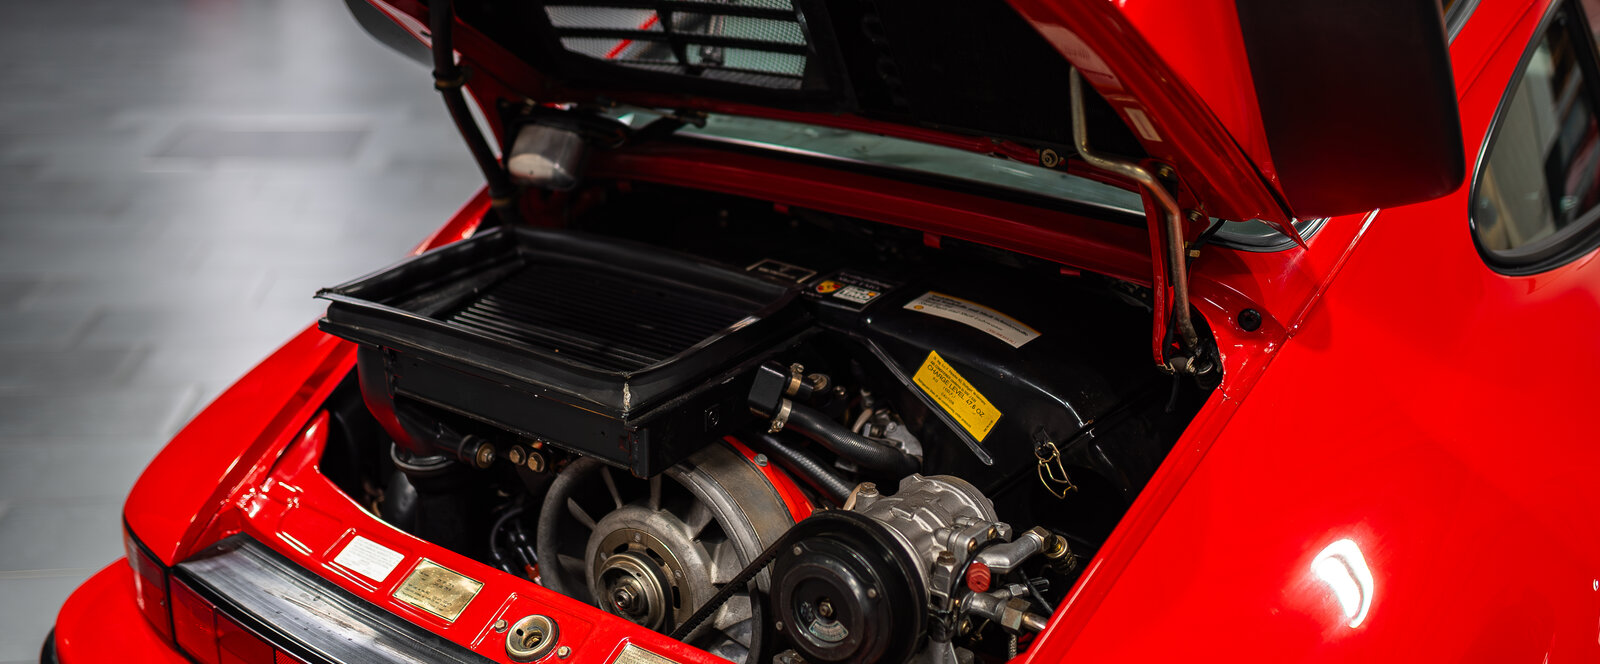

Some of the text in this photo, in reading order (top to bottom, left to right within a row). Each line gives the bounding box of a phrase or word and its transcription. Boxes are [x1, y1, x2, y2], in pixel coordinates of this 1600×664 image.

[927, 364, 949, 385] CHARGE
[948, 382, 965, 399] LEVEL
[976, 408, 985, 418] OZ
